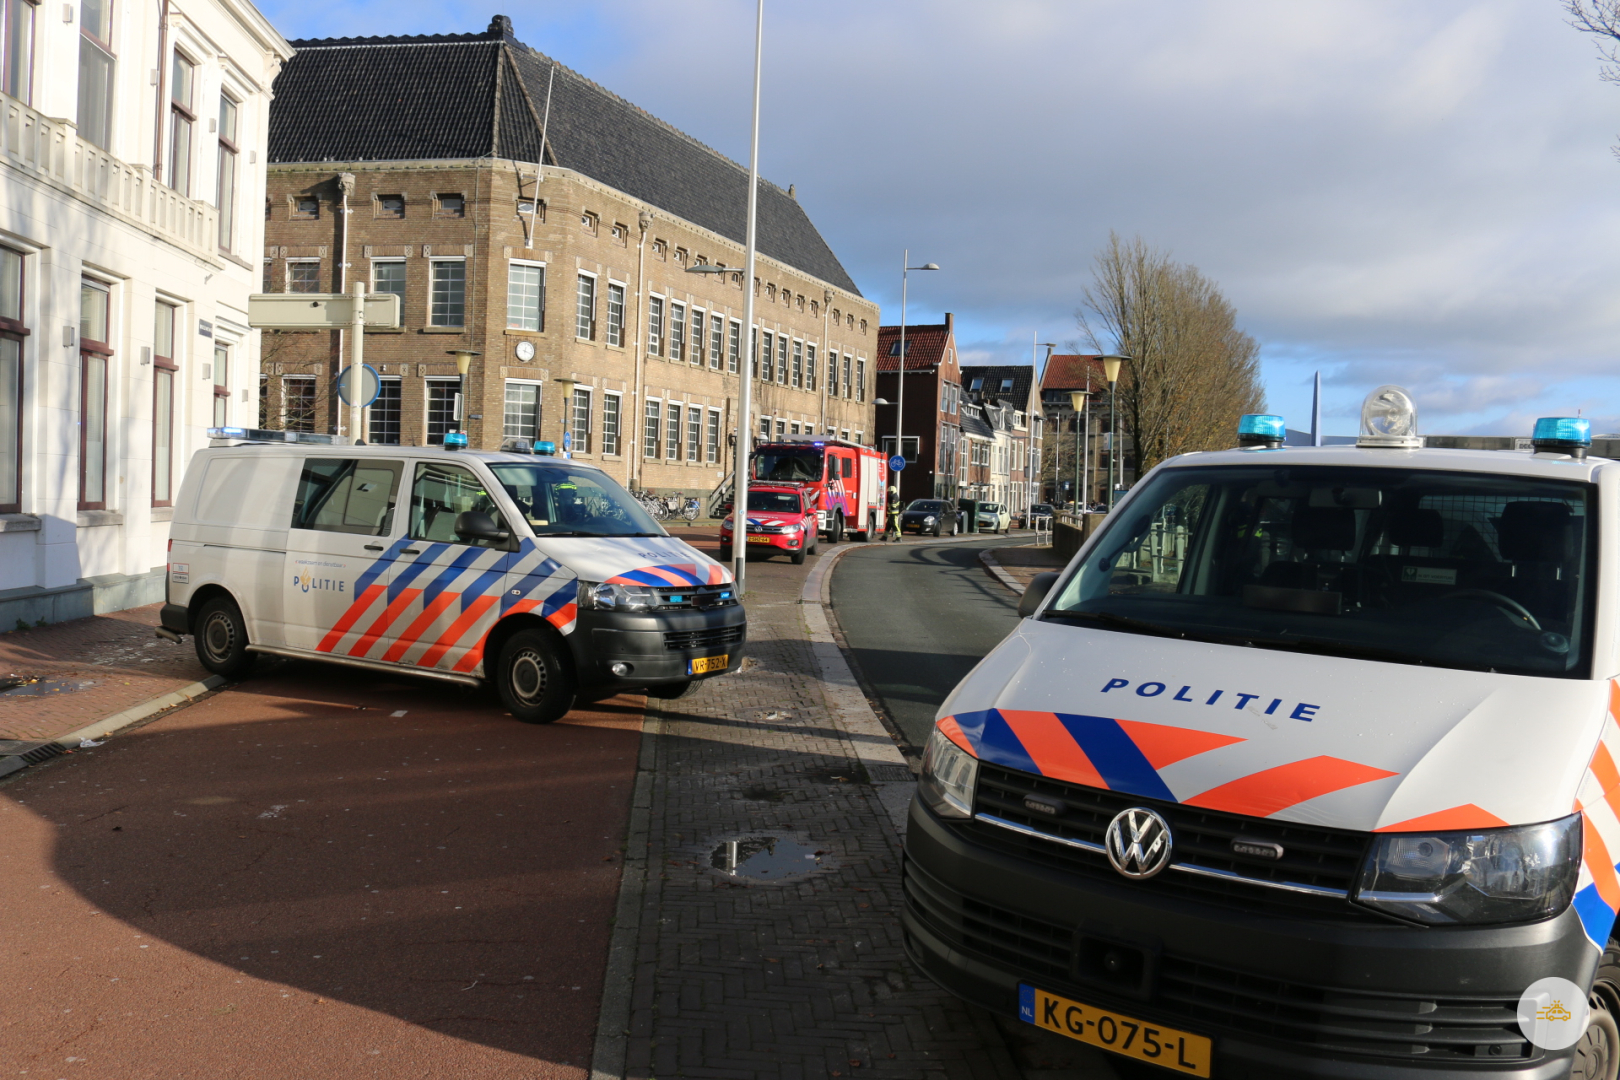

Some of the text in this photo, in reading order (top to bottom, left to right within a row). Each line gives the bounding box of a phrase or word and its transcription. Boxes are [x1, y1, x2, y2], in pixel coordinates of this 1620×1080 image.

[637, 551, 691, 559] POLITIE
[293, 575, 345, 593] POLITIE
[694, 656, 726, 671] VR-752-X
[1100, 678, 1321, 723] POLITIE
[1021, 1005, 1033, 1018] NL
[1044, 997, 1196, 1070] KG-075-L
